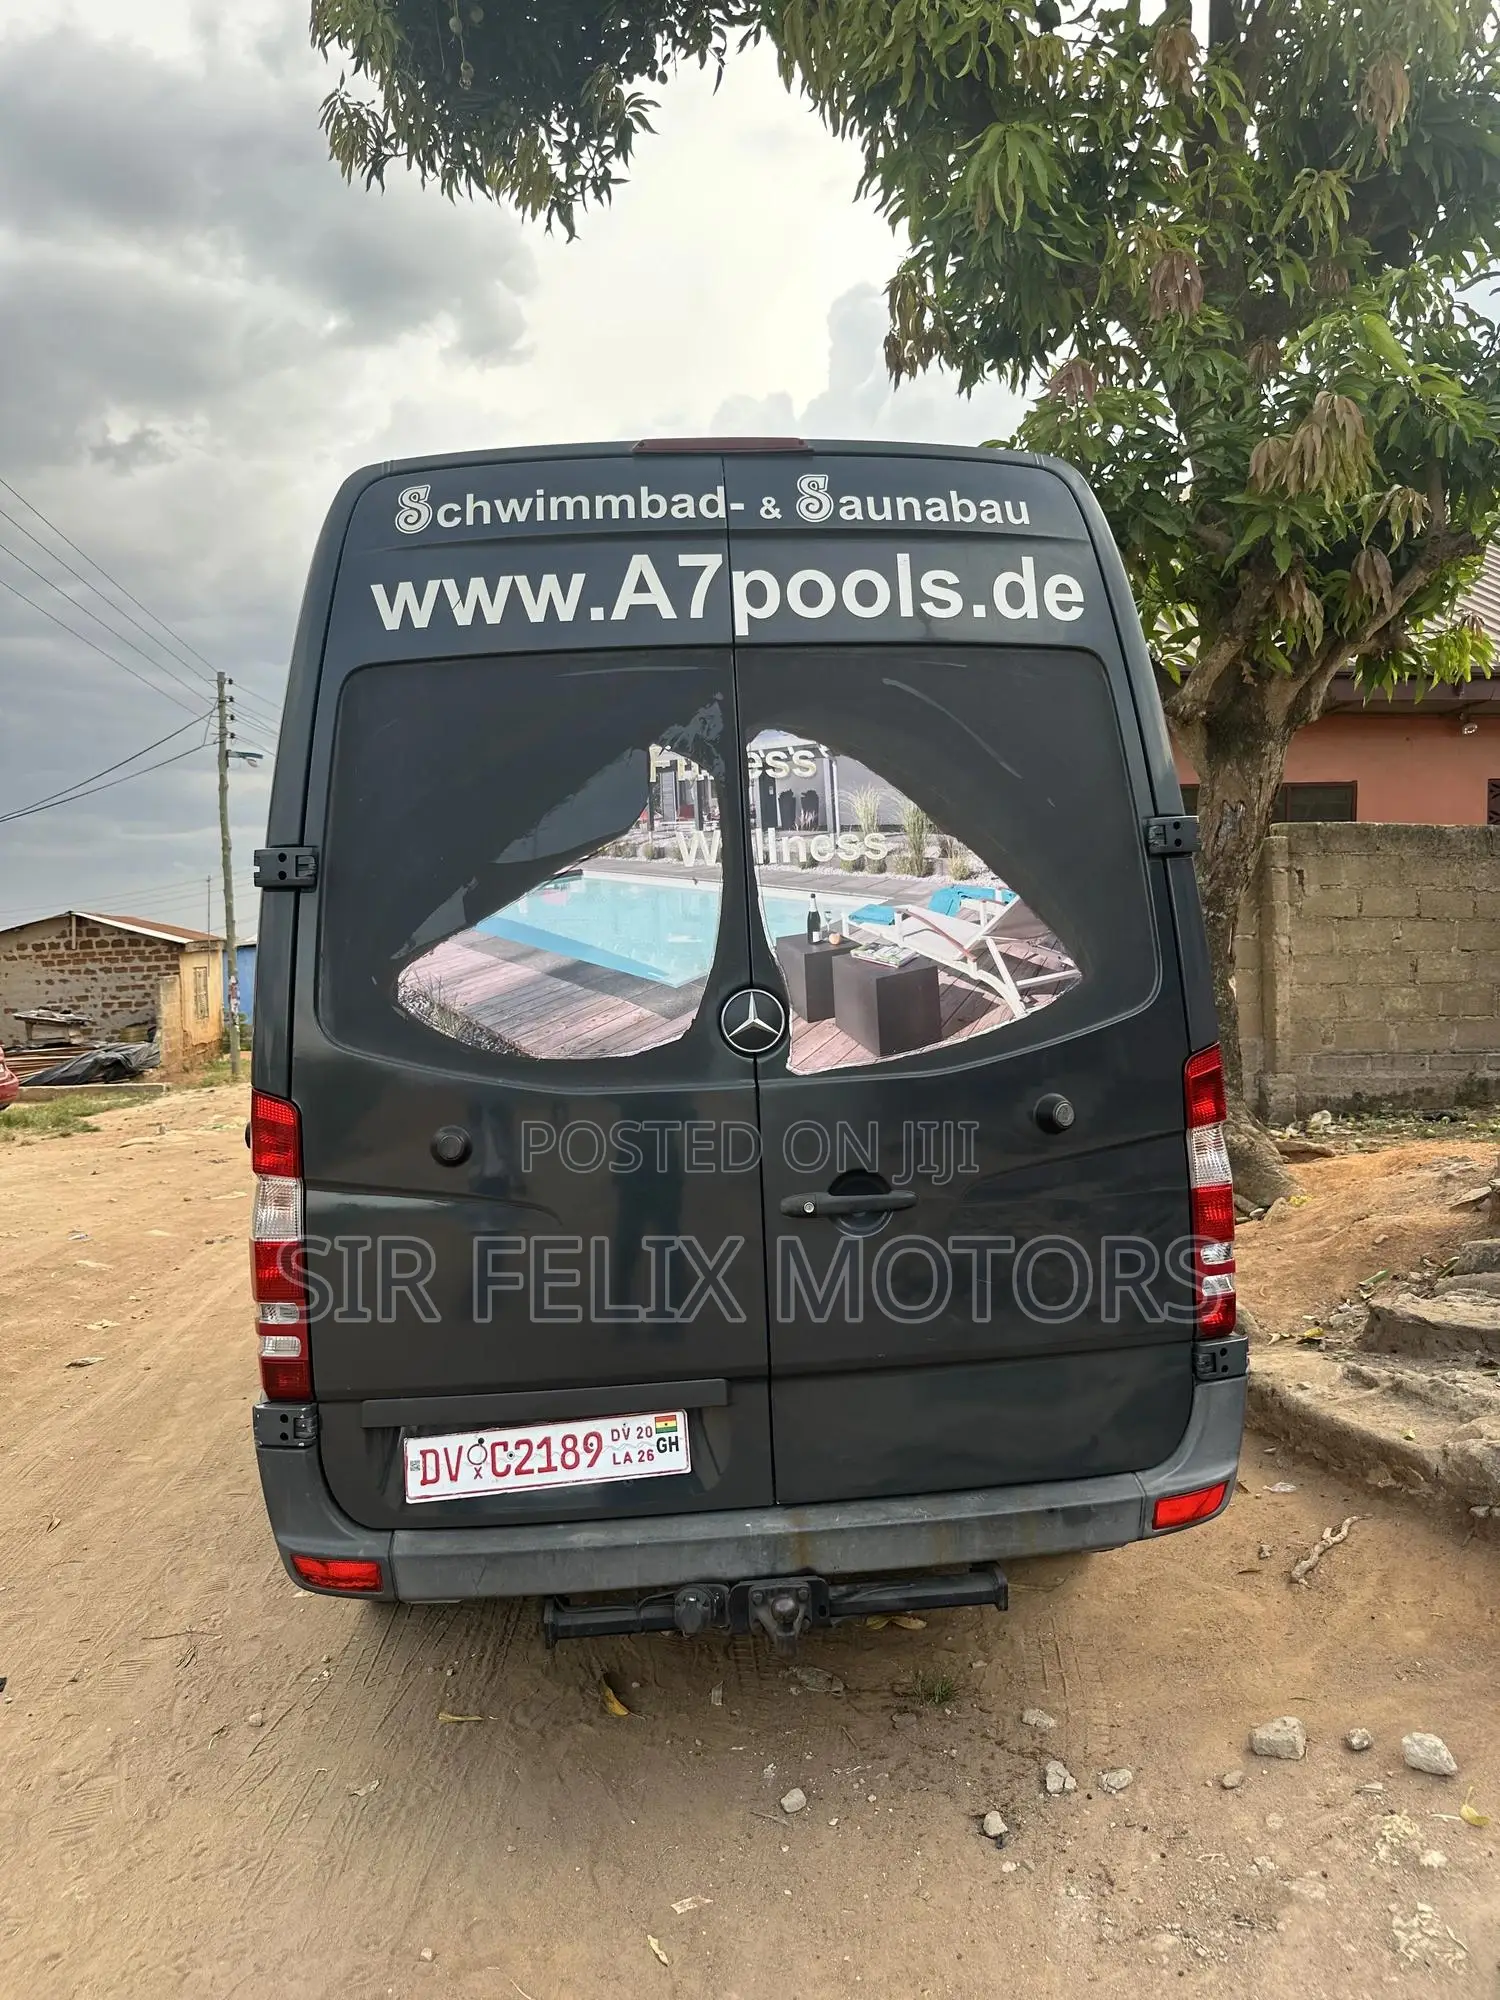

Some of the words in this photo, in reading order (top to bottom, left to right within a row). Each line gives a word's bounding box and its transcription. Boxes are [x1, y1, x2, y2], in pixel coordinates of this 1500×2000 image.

[395, 484, 745, 533] Schwimmbad-
[760, 496, 782, 520] &
[797, 473, 1030, 526] Saunabau
[370, 552, 1086, 636] www.A7pools.de
[675, 827, 889, 867] Wllness
[611, 1427, 630, 1442] DV
[636, 1425, 653, 1440] 20
[656, 1435, 680, 1454] GH
[419, 1445, 463, 1486] DV
[490, 1430, 603, 1478] C2189
[612, 1450, 633, 1466] LA
[637, 1448, 655, 1463] 26
